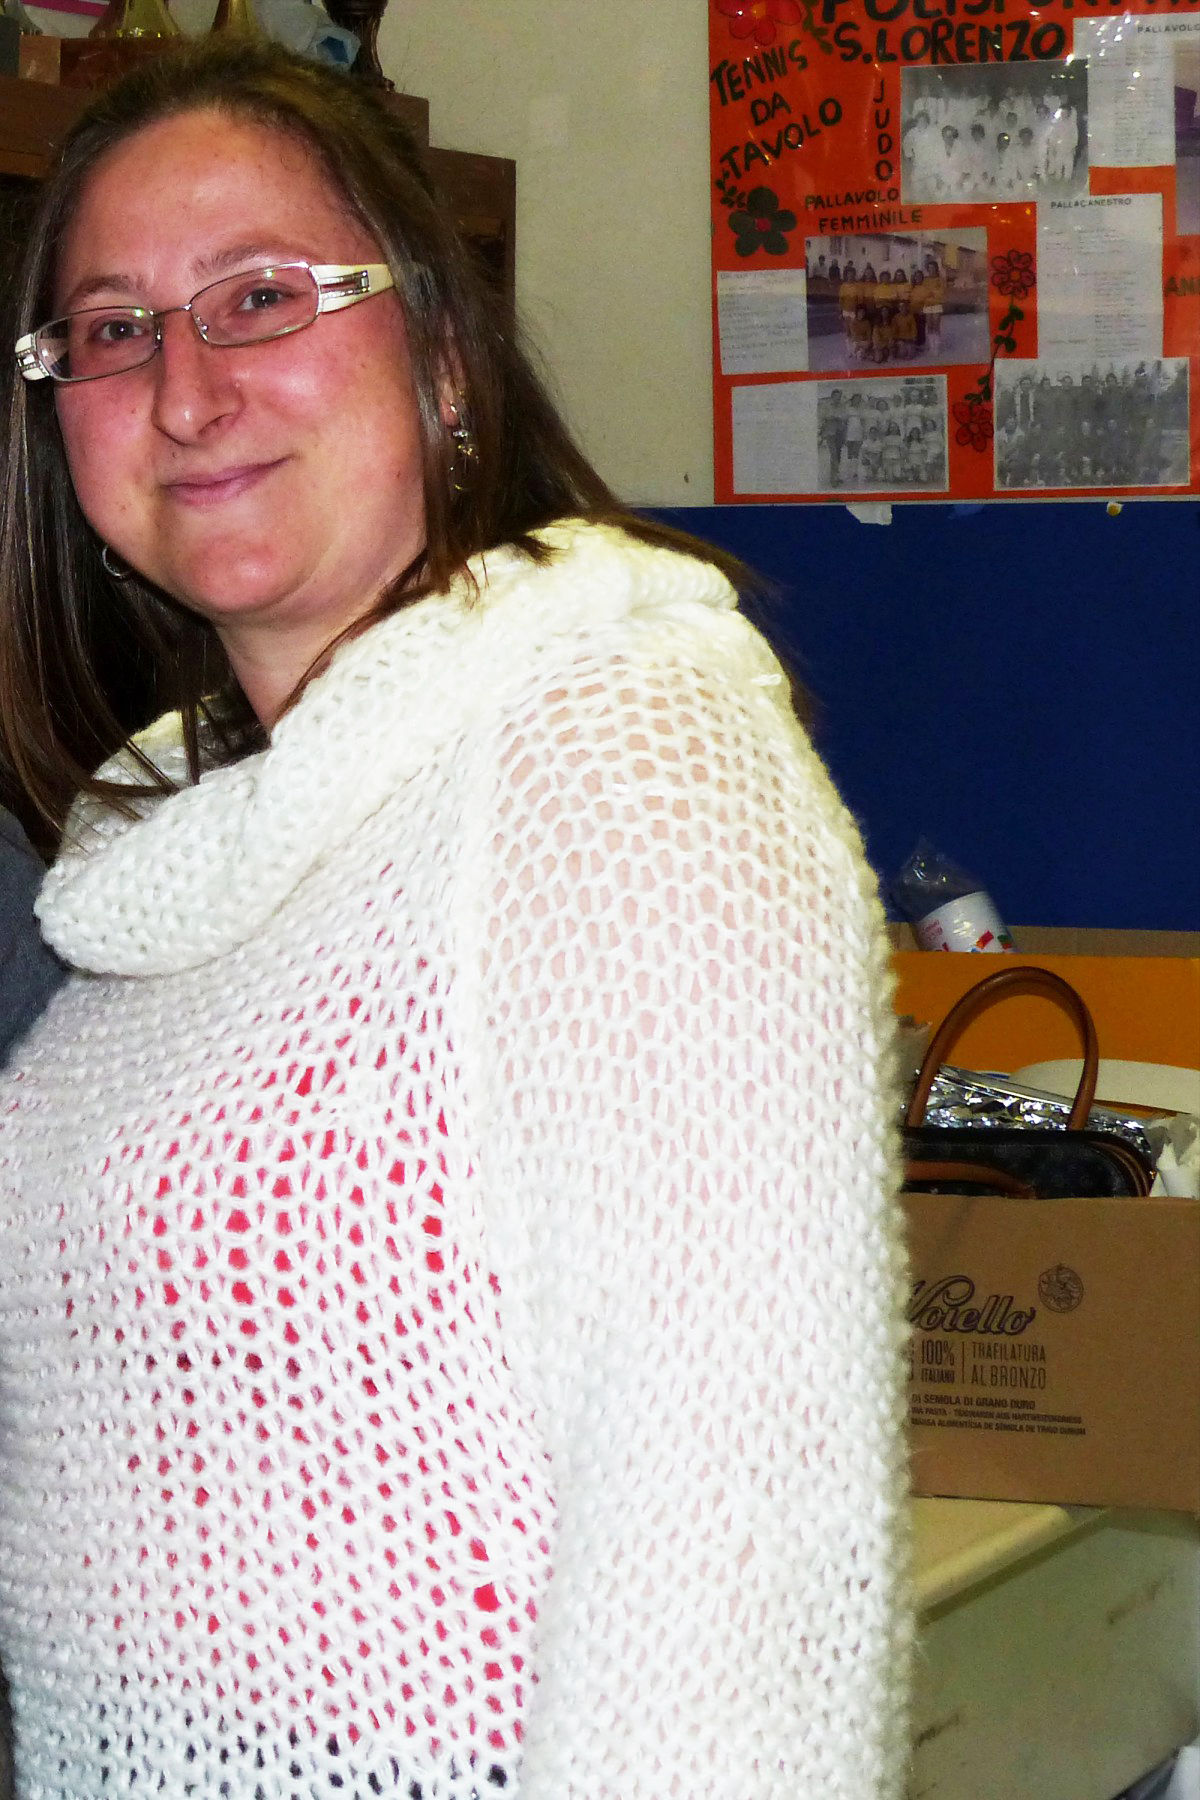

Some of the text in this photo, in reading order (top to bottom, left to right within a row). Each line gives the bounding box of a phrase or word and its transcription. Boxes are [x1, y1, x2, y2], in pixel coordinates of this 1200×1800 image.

[710, 40, 808, 106] TENNIS
[751, 92, 791, 126] DA
[720, 98, 842, 179] TAVOLO
[873, 79, 893, 181] JUDO
[805, 188, 899, 210] PALLAVOLO
[1051, 198, 1132, 210] PALLACANESTRO
[819, 208, 922, 232] FEMMINILE
[921, 1339, 955, 1366] 100%
[972, 1341, 1046, 1364] TRAFILATURA
[971, 1365, 1046, 1390] AL BRONZO
